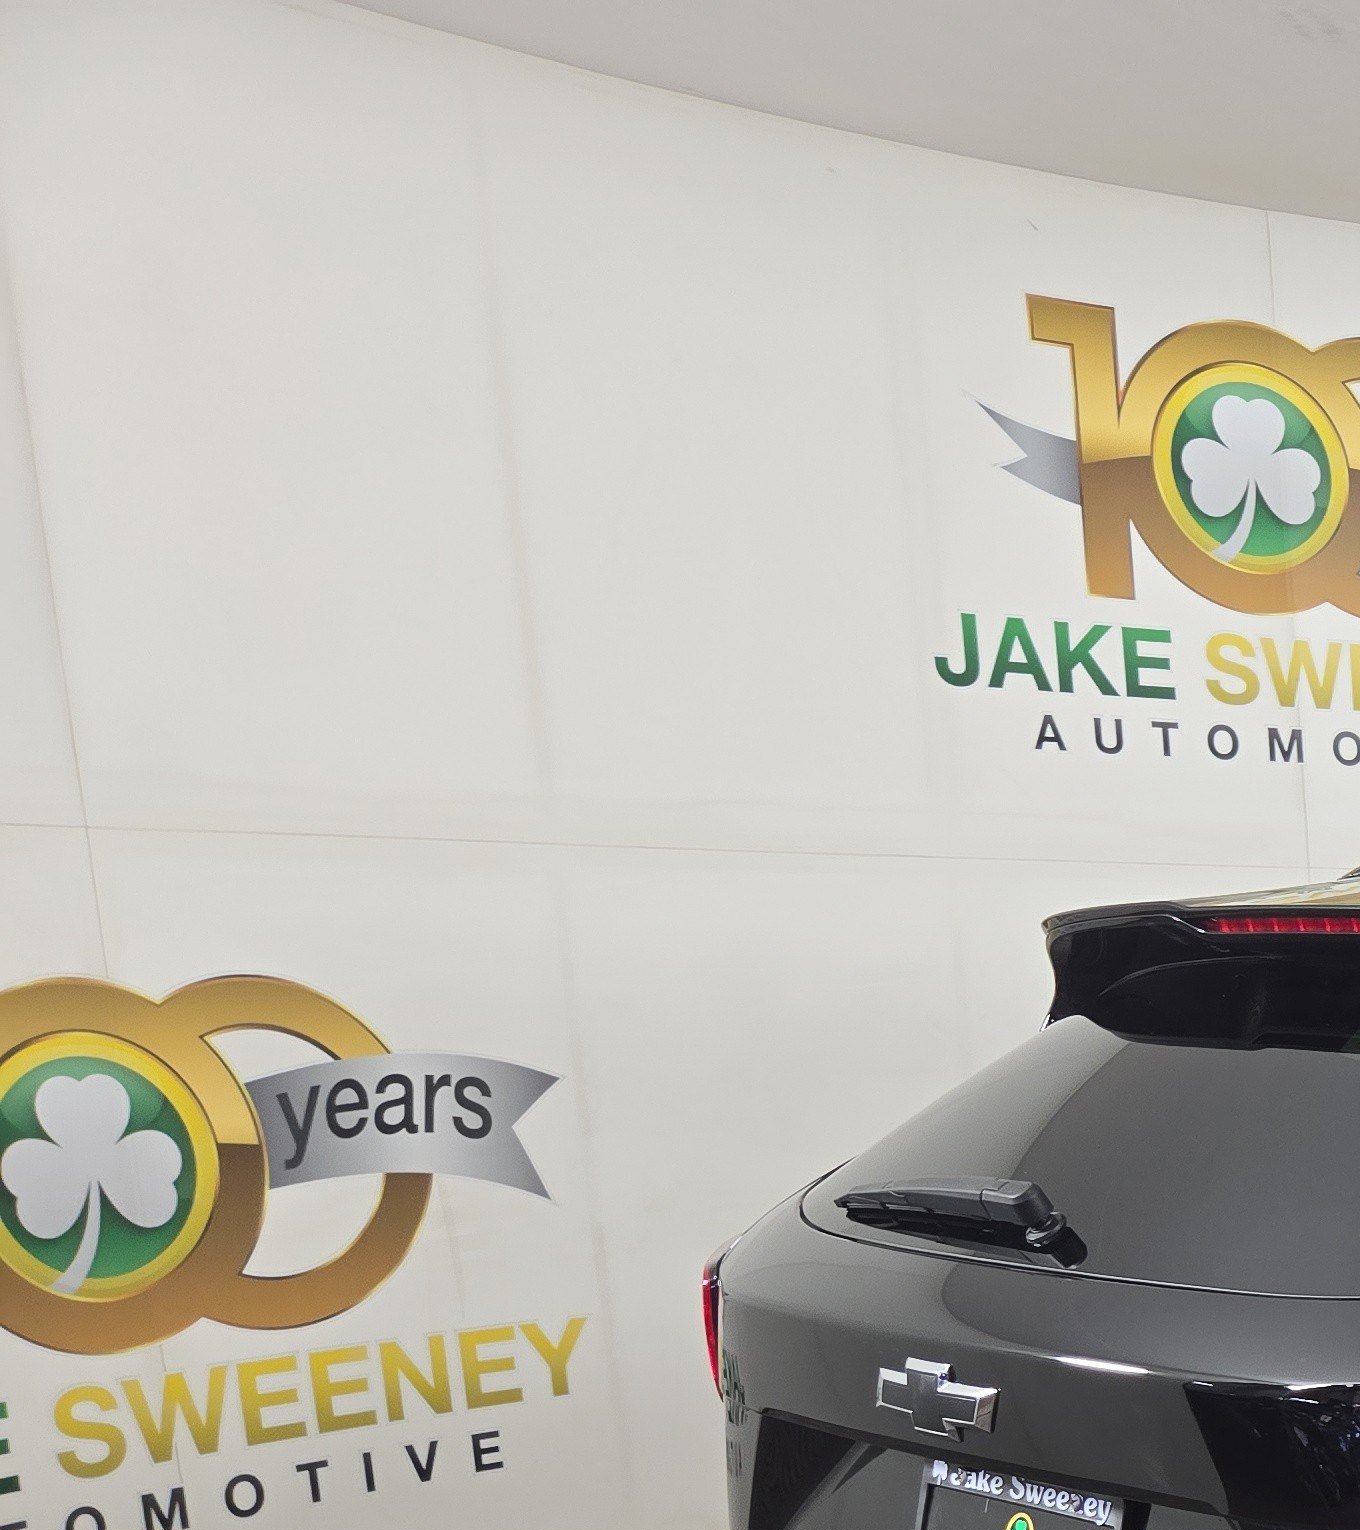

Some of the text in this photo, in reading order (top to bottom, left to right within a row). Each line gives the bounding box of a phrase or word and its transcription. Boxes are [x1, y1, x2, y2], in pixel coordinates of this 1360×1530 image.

[934, 612, 1177, 700] JAKE
[276, 1072, 494, 1170] years
[53, 1317, 588, 1480] SWEENEY
[950, 1468, 1112, 1526] Jake Sweeney
